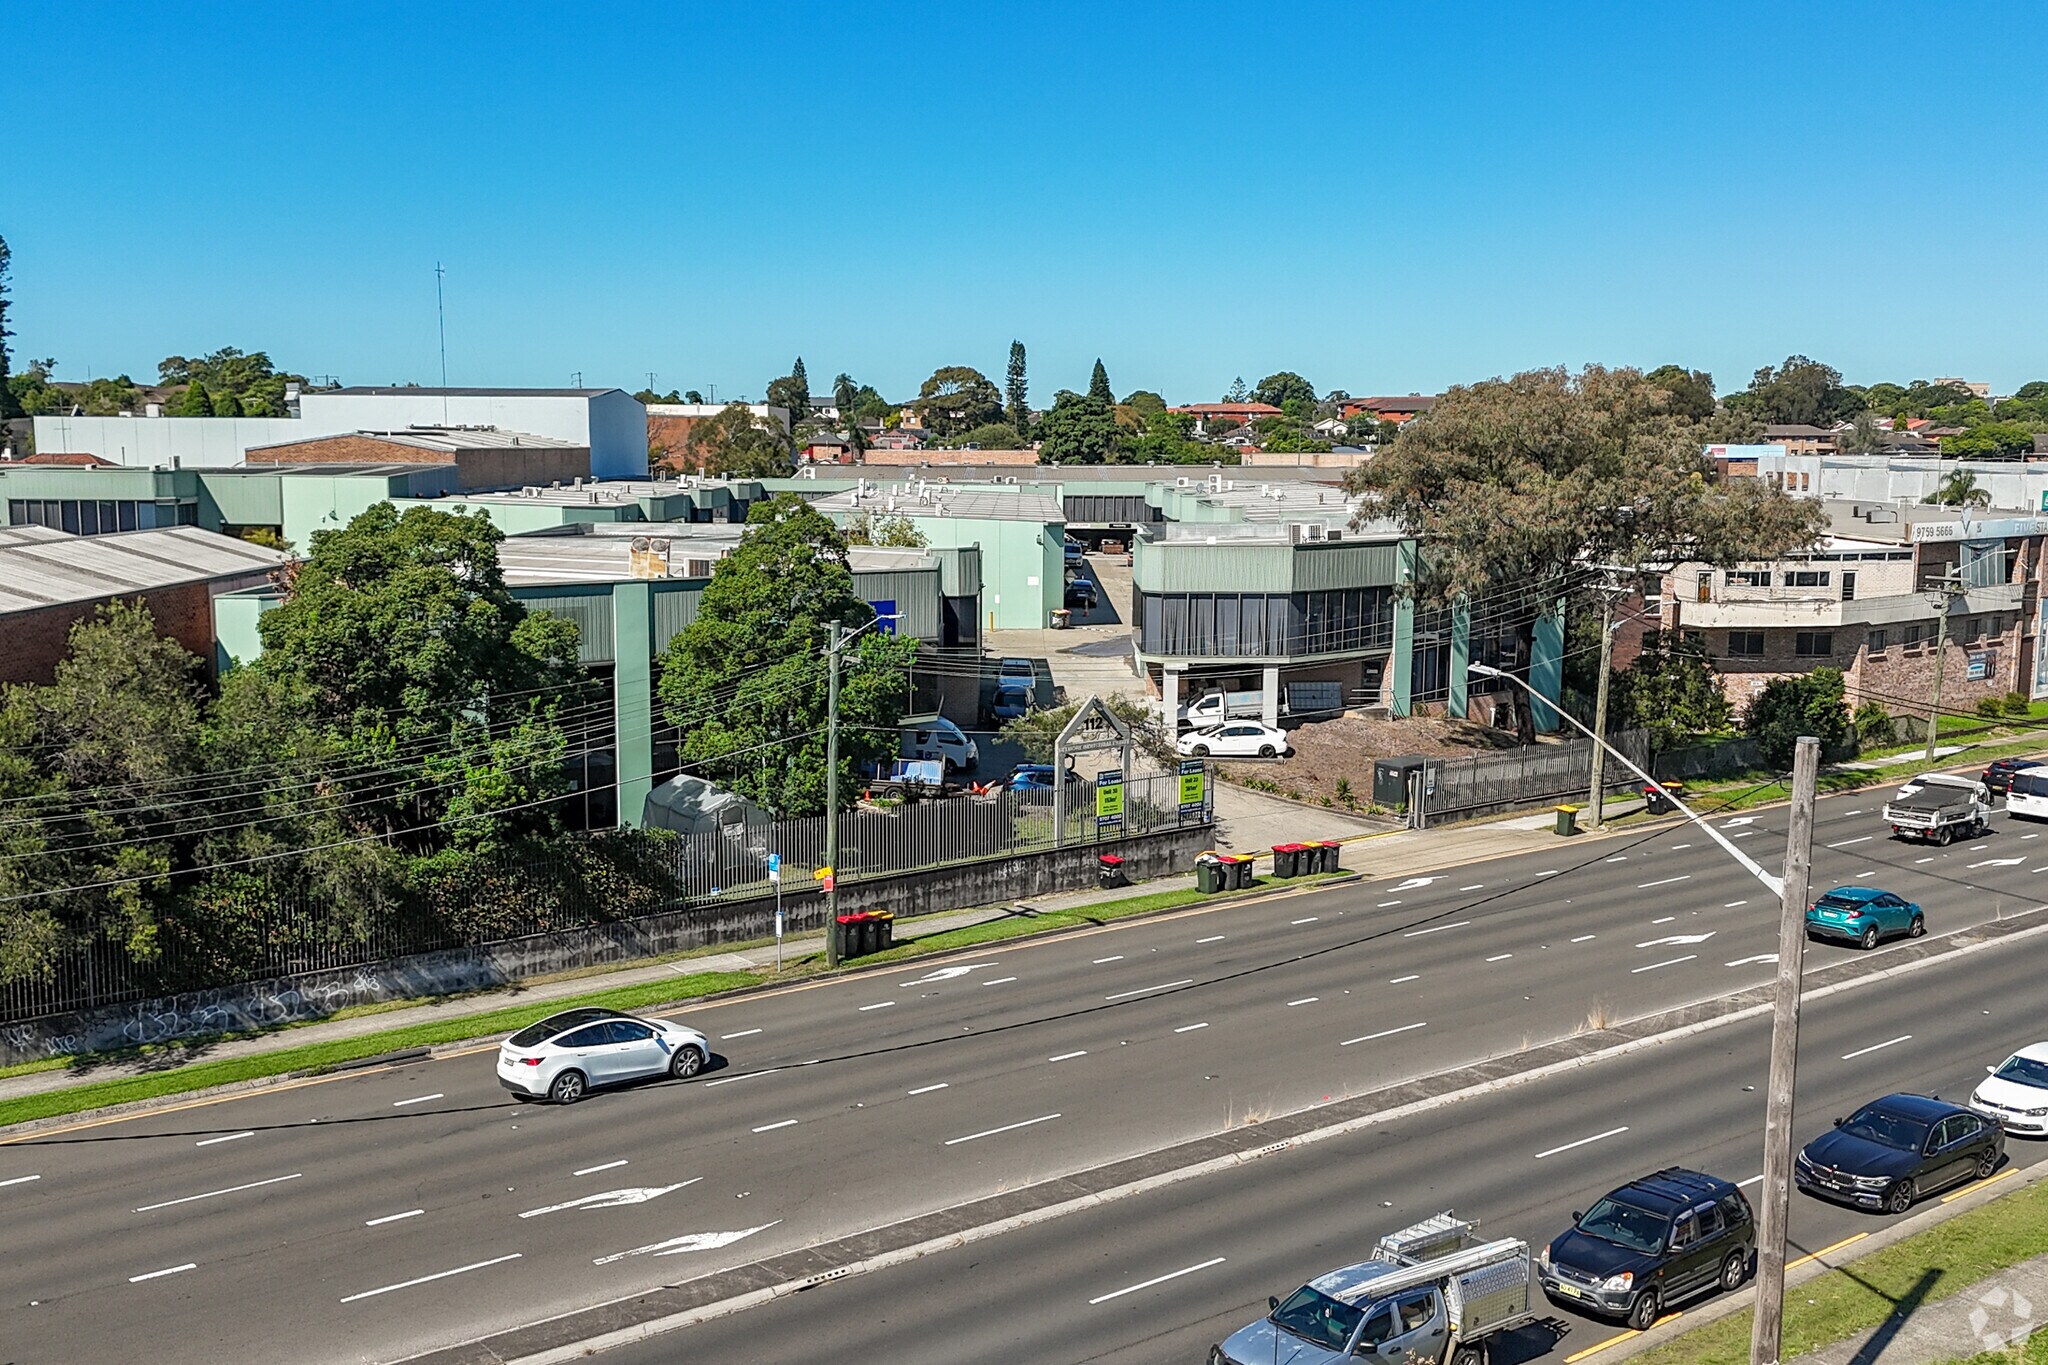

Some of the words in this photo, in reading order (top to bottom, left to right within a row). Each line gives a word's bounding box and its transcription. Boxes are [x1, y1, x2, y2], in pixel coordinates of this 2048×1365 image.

[1916, 526, 1934, 537] 9759
[1936, 525, 1953, 536] 5666
[2014, 522, 2035, 534] FIVE
[1084, 717, 1103, 731] 112
